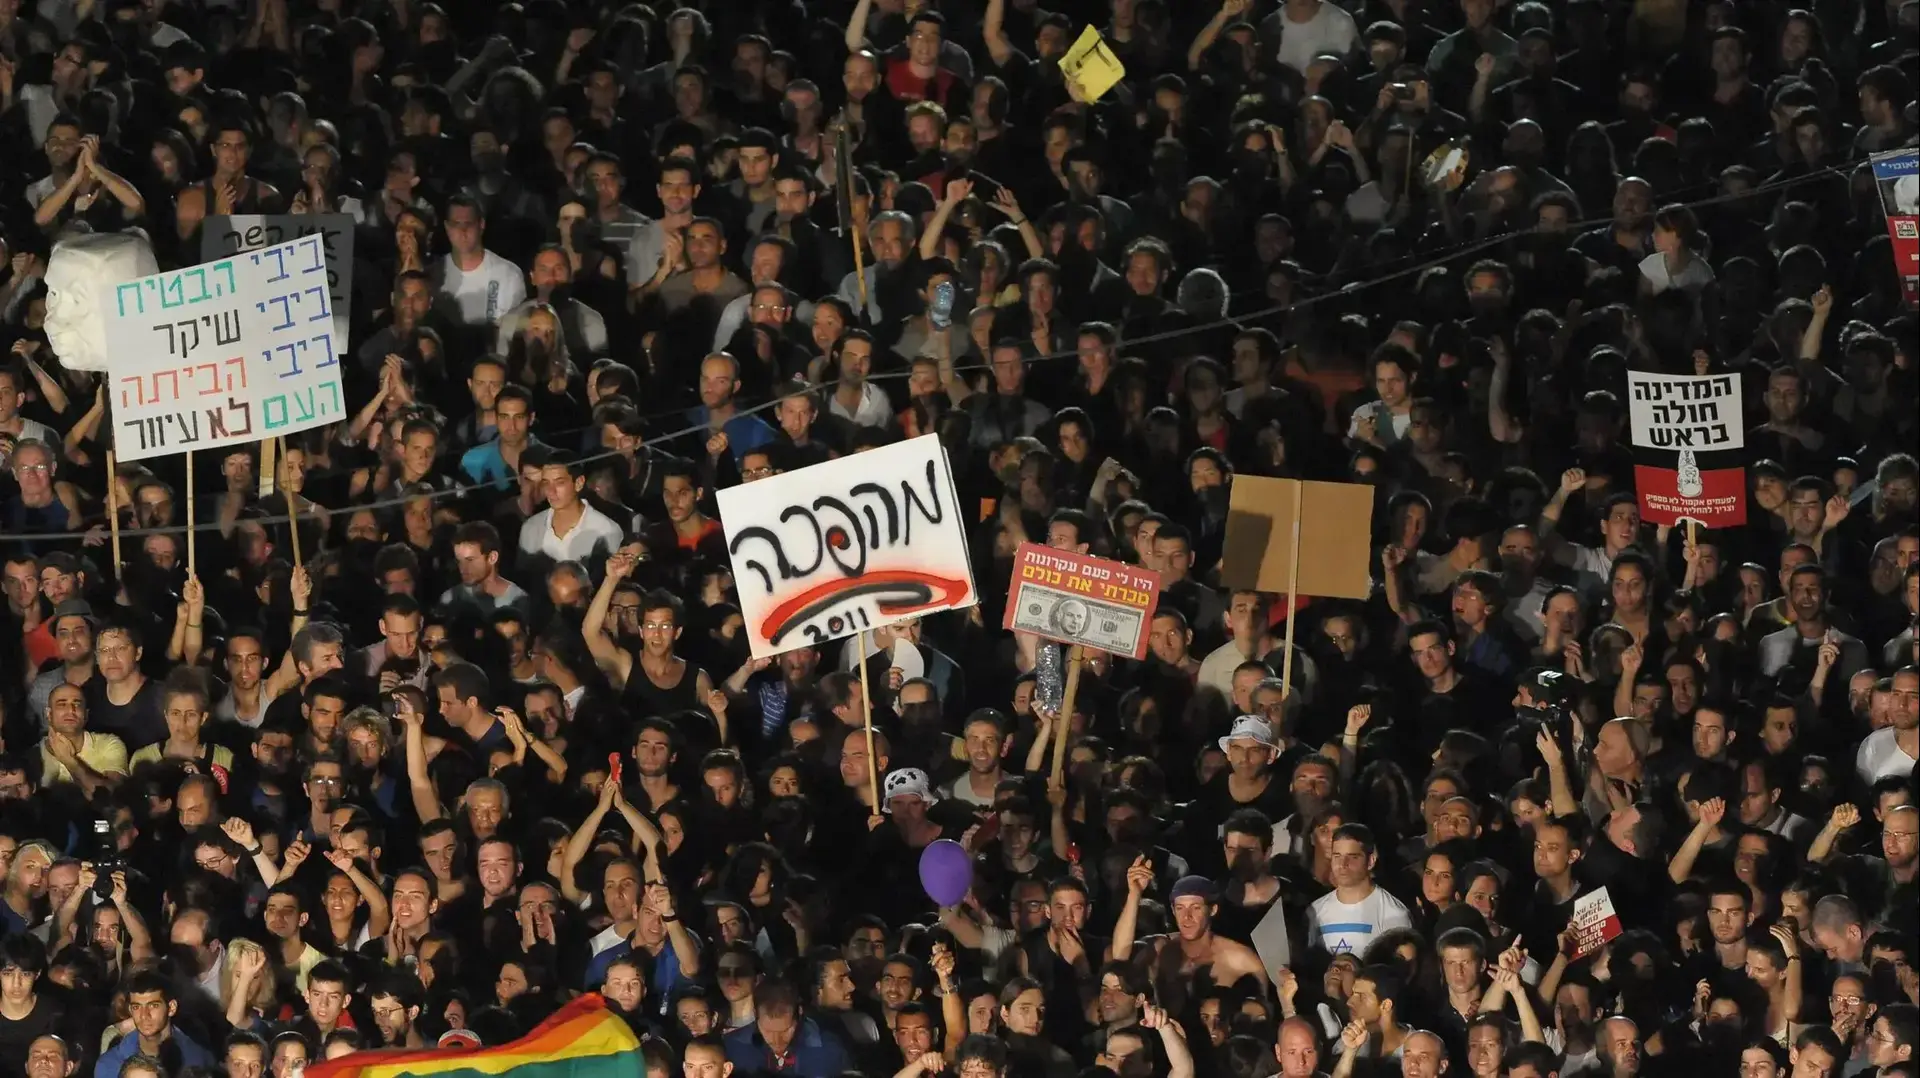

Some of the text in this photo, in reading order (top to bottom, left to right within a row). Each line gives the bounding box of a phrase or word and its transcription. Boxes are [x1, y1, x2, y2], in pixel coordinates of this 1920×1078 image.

[250, 238, 324, 283] ביבי
[116, 260, 236, 317] הבטיח
[153, 285, 331, 358] ביבי שיקר
[121, 333, 338, 408] ביבי הביתה
[1633, 377, 1733, 401] המדינה
[124, 381, 340, 450] העם לא עיוור
[1652, 401, 1719, 424] חולה
[1649, 424, 1730, 447] בראש
[1645, 493, 1736, 507] לפעמים אקמול לא מספיק
[1672, 505, 1682, 513] את
[1683, 506, 1712, 515] להחליף
[1714, 504, 1735, 514] וצריך
[730, 459, 944, 594] מהפכה
[1022, 564, 1151, 606] מכרתי את כולם
[1024, 551, 1153, 591] היו לי פעם עקרונות
[806, 606, 871, 644] 2011
